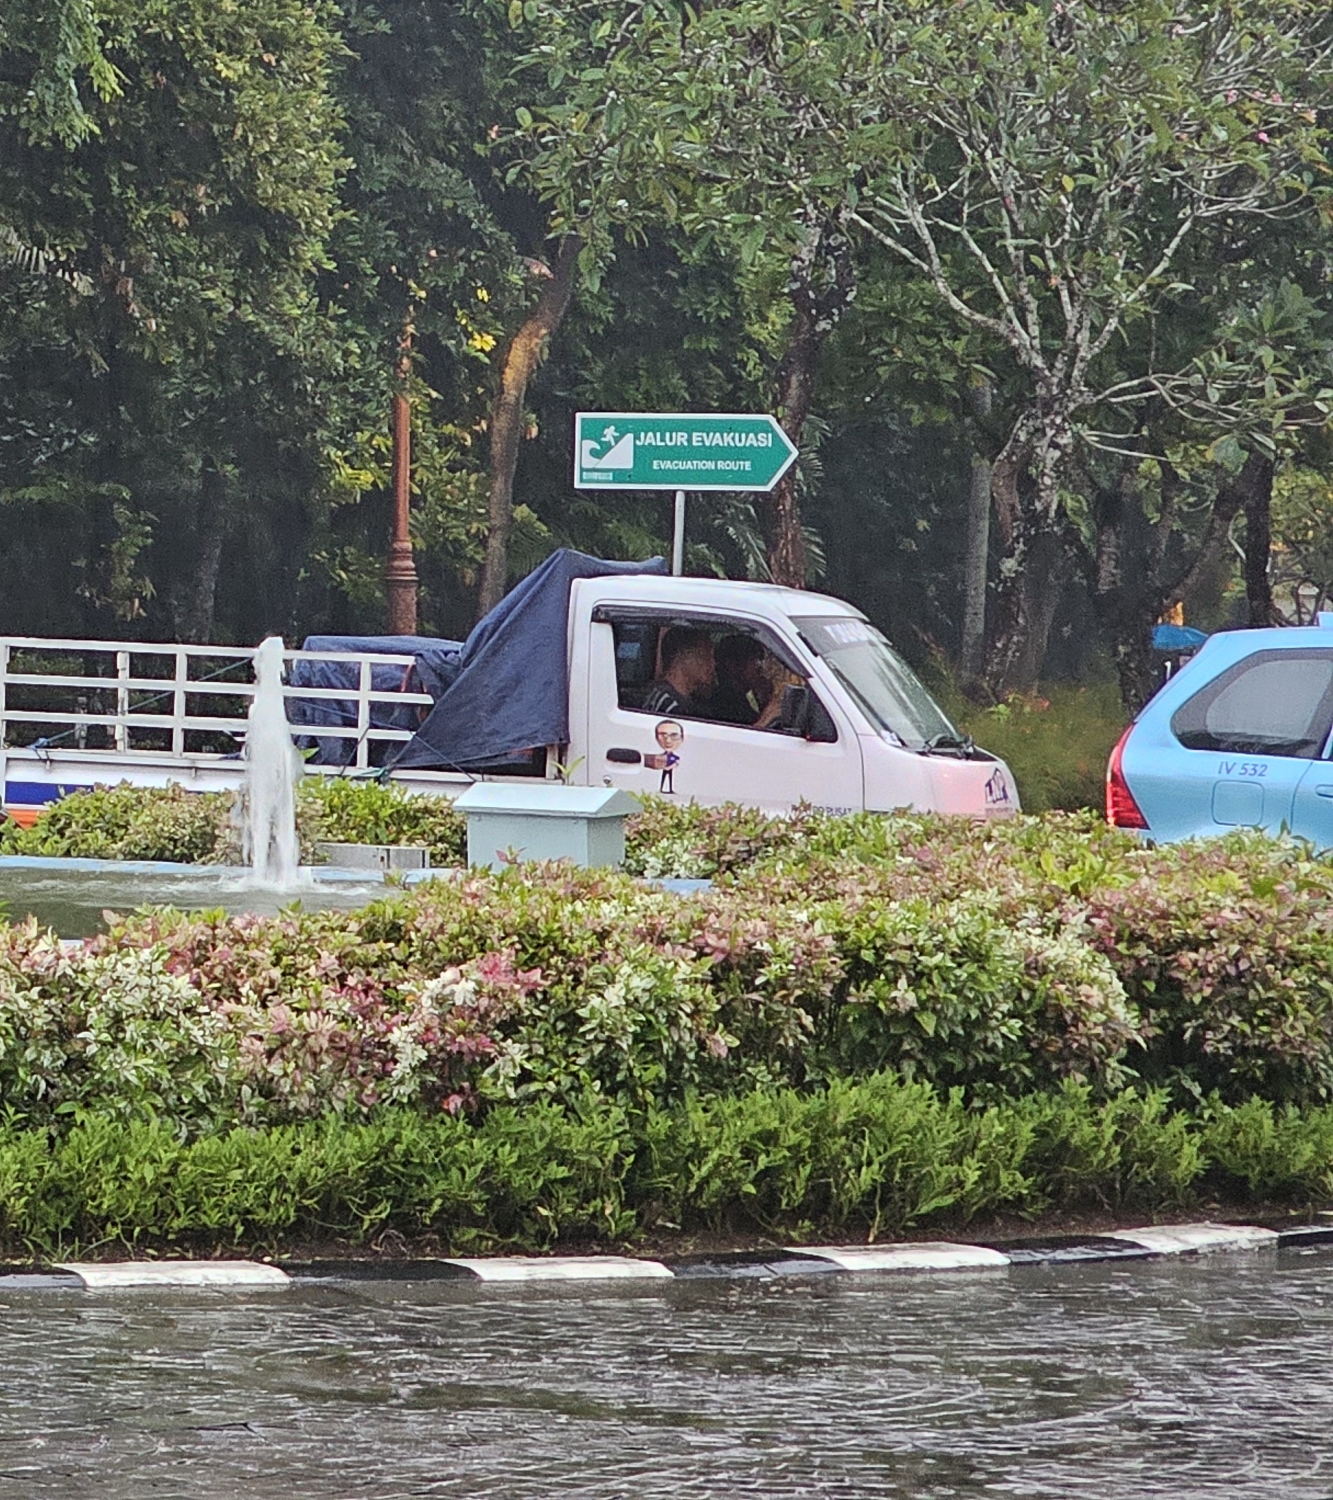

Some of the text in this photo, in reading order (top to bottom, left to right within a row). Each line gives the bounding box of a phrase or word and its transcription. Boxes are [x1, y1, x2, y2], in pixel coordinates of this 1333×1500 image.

[635, 431, 772, 448] JALUR EVAKUASI
[653, 460, 752, 471] EVACUATION ROUTE
[1218, 761, 1268, 777] IV 532
